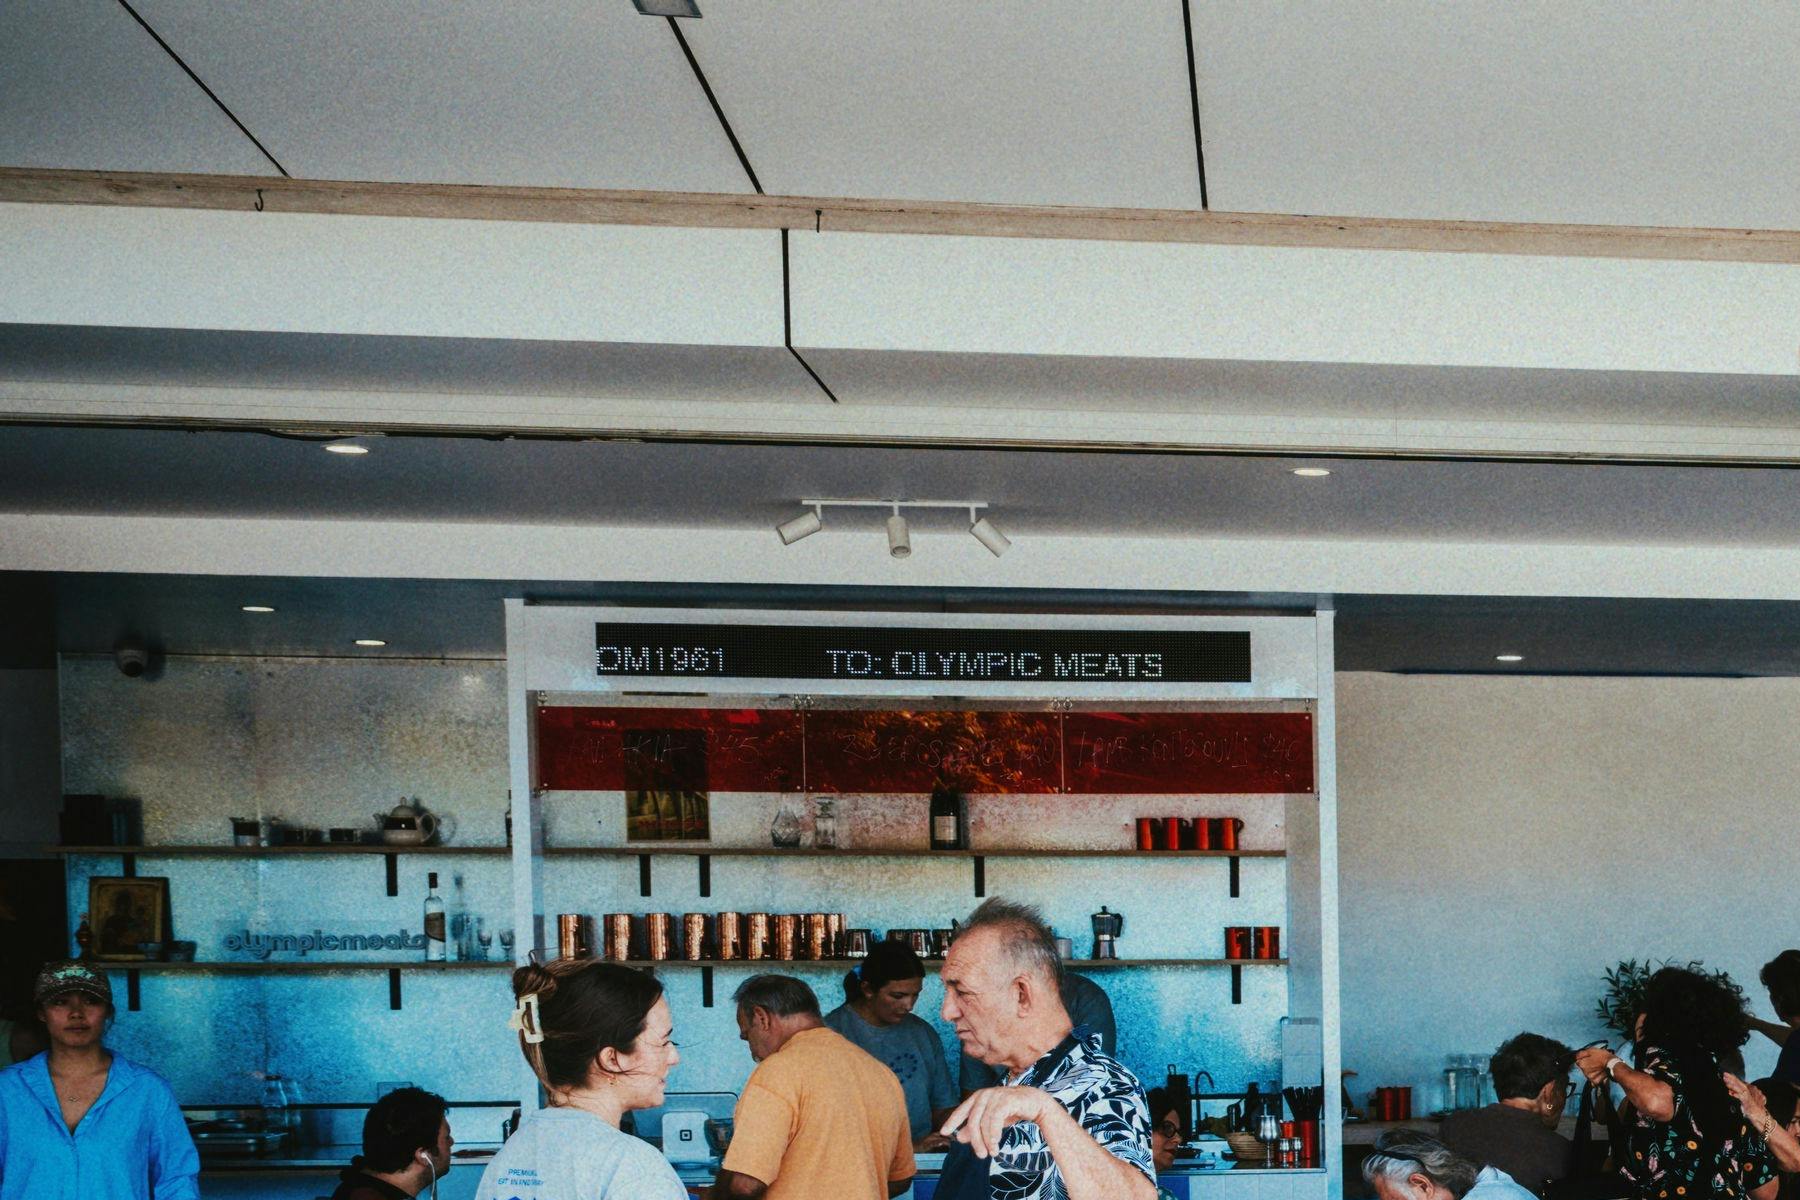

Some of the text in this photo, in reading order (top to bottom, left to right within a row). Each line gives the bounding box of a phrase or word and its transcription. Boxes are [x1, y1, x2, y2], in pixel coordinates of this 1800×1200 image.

[826, 649, 882, 675] TO:
[891, 650, 1042, 676] OLYMPIC
[1054, 652, 1163, 677] MEATS
[223, 928, 428, 960] olympicmeats
